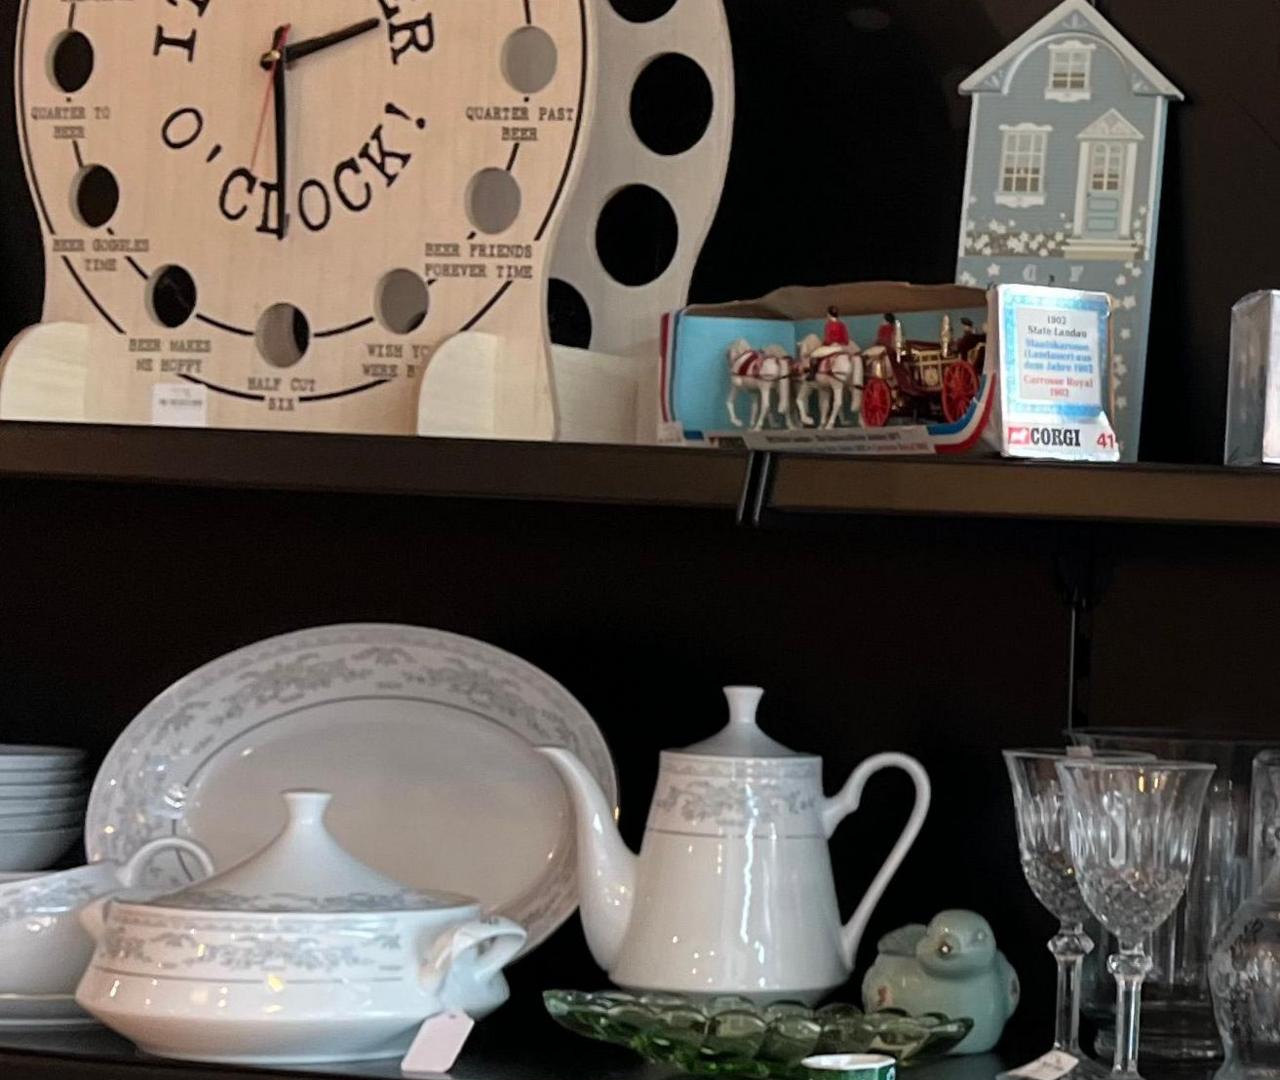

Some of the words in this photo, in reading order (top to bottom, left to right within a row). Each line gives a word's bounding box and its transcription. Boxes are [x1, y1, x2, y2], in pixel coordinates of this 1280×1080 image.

[31, 106, 86, 120] QUARTER
[94, 106, 111, 120] TO
[465, 106, 529, 121] QUARTER
[538, 107, 574, 121] PAST
[53, 126, 86, 139] BEER
[501, 127, 538, 141] BEER
[52, 239, 85, 252] BEER
[92, 239, 149, 252] GOGGLES
[425, 243, 460, 257] BEER
[469, 244, 532, 259] FRIENDS
[85, 258, 117, 272] TIME
[425, 263, 487, 278] FOREVER
[496, 265, 533, 279] TIME
[1054, 327, 1087, 338] Landau
[129, 338, 161, 352] BEER
[170, 339, 211, 353] MAKES
[367, 344, 403, 358] WISH
[136, 358, 153, 372] ME
[248, 377, 282, 391] HALF
[290, 378, 316, 393] CUT
[268, 397, 295, 411] SIX
[1030, 427, 1080, 447] CORGI
